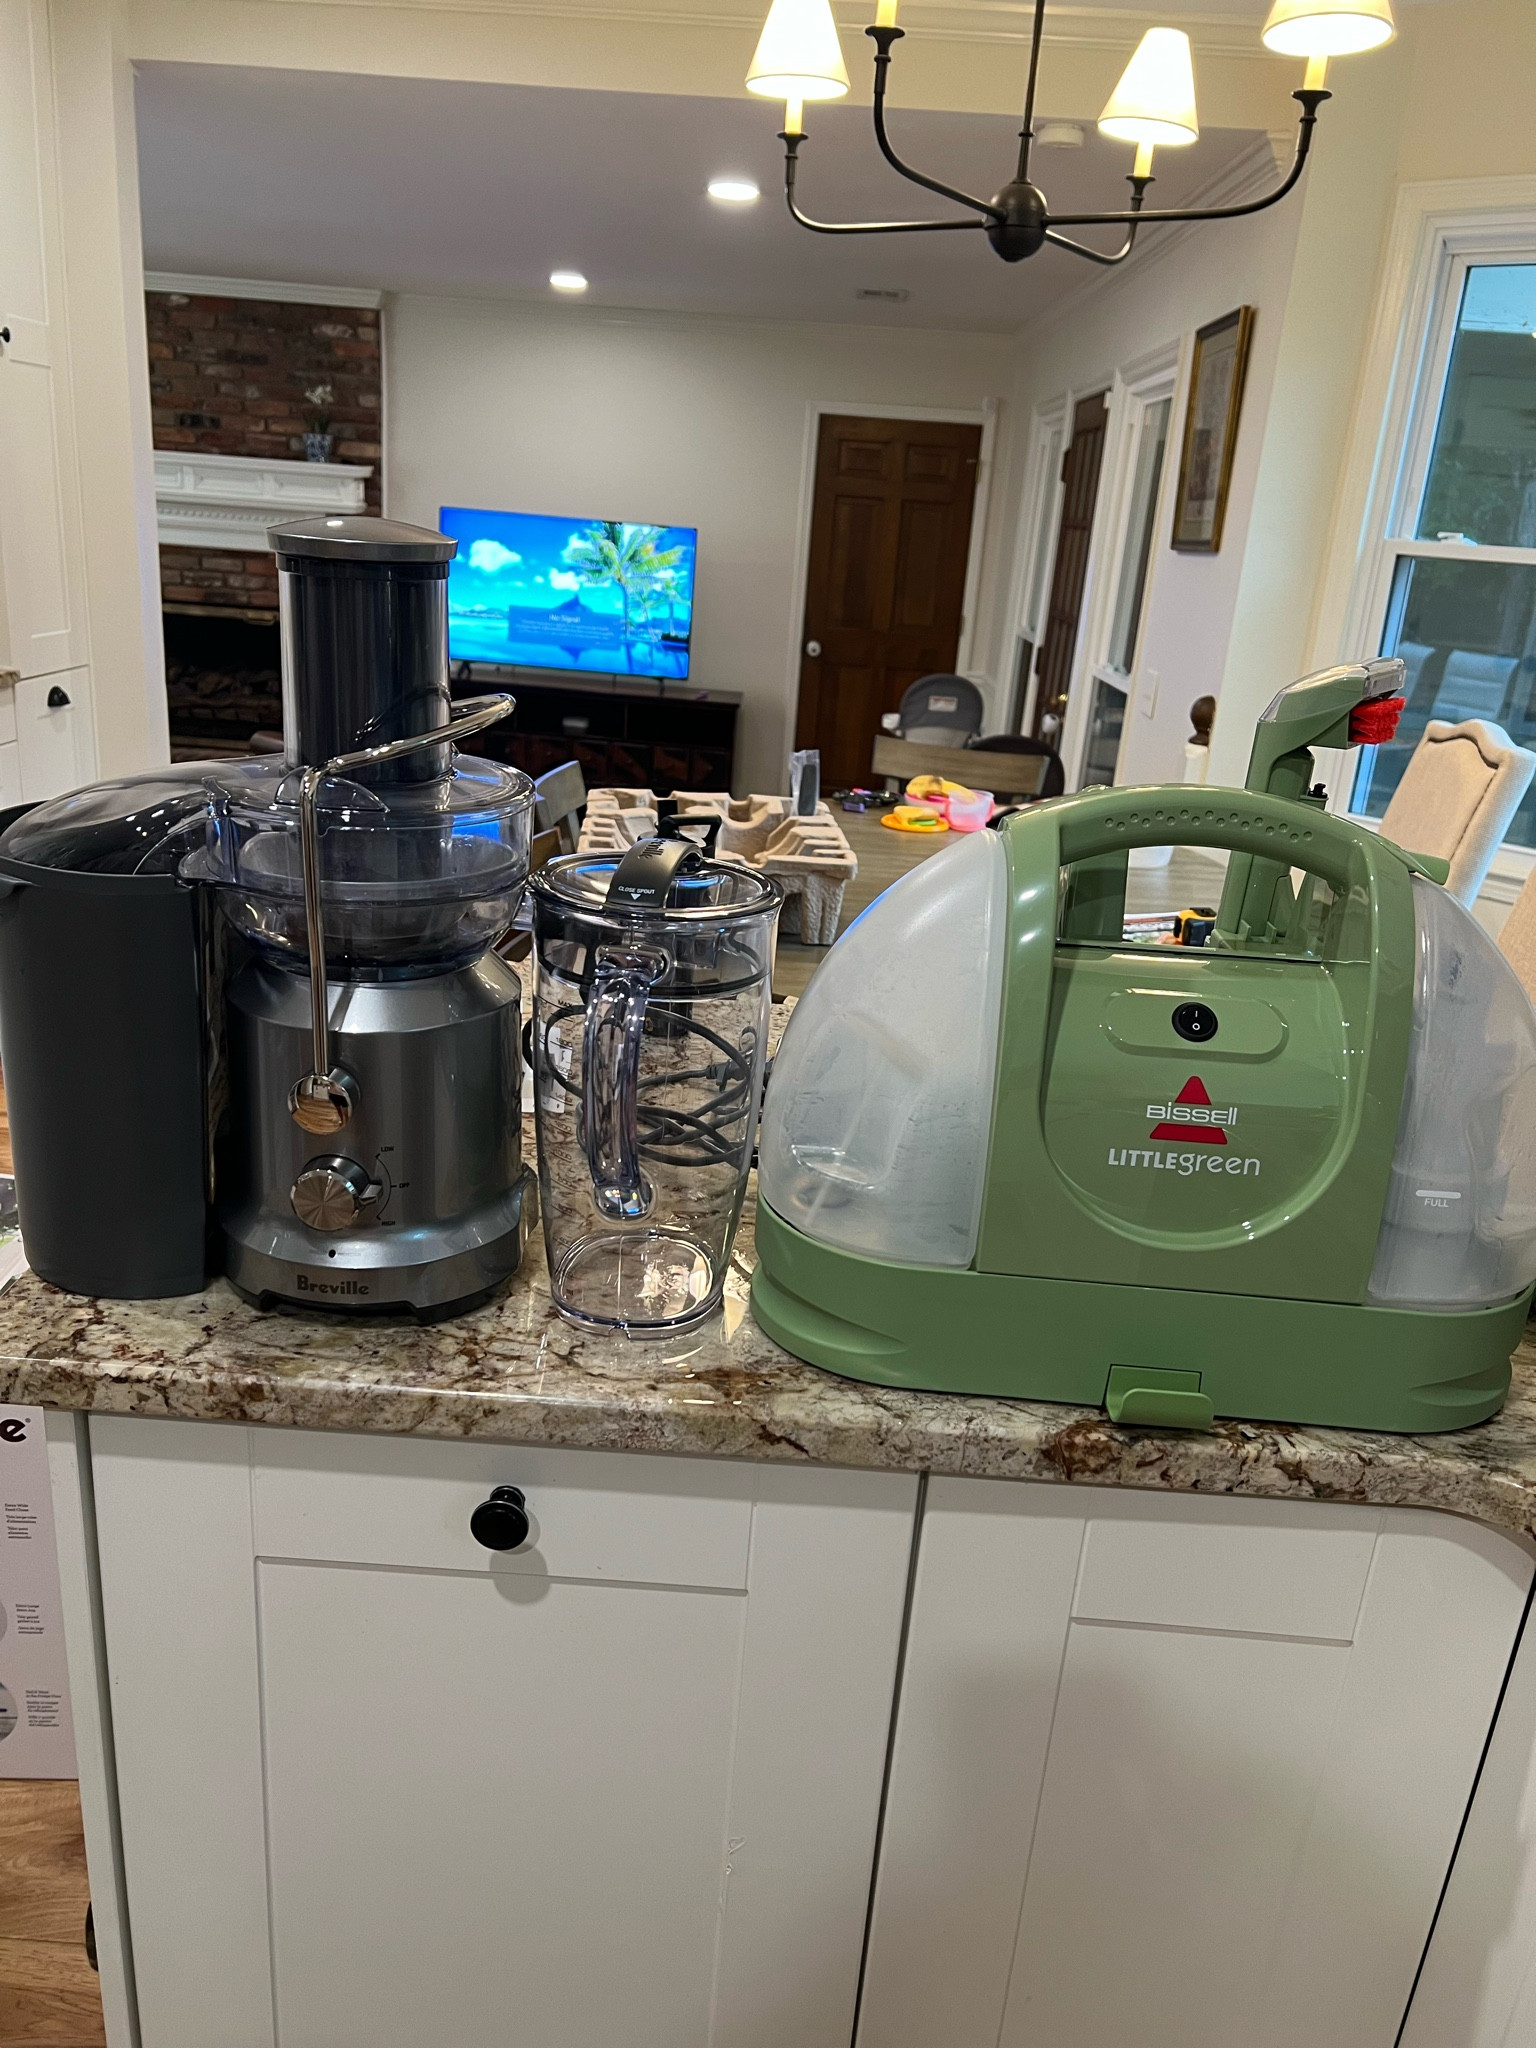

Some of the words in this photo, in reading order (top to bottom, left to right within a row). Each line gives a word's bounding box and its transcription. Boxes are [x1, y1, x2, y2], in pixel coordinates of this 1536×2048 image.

[618, 885, 635, 893] CLOSE
[1424, 1198, 1449, 1208] FULL
[296, 1274, 370, 1295] Breville
